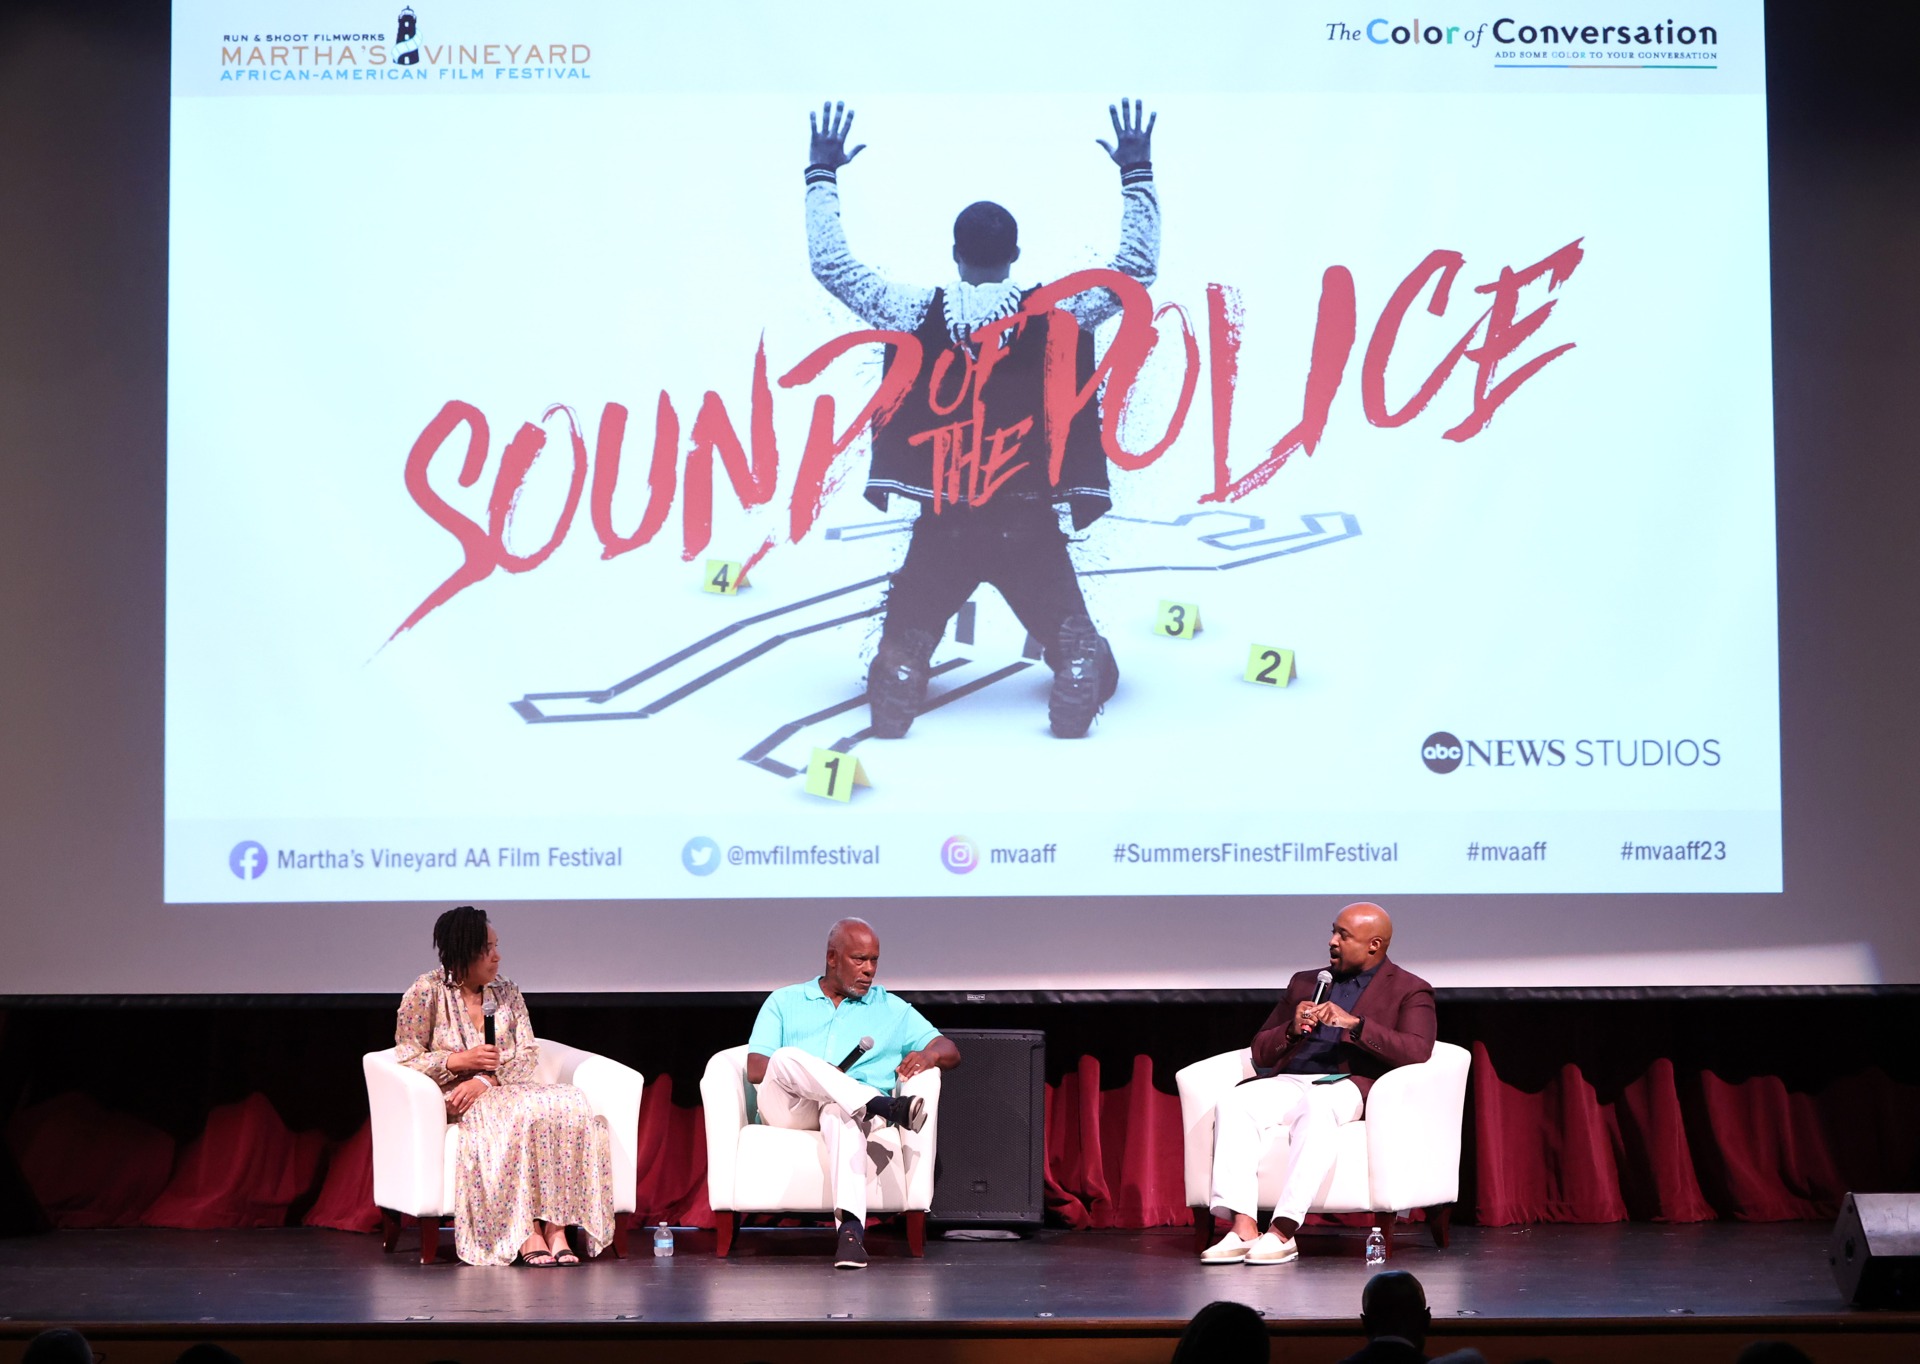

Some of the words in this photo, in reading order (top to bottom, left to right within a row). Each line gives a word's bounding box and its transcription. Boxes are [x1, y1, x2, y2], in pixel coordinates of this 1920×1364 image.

[223, 34, 249, 42] RUN
[253, 34, 262, 42] &
[265, 34, 310, 42] SHOOT
[313, 33, 385, 41] FILMWORKS
[1326, 22, 1361, 41] The
[1366, 18, 1460, 45] Color
[1464, 23, 1488, 48] of
[1492, 17, 1718, 45] Conversation
[221, 44, 387, 66] MARTHA'S
[423, 44, 591, 65] VINEYARD
[1495, 51, 1516, 59] ADD
[1519, 51, 1548, 59] SOME
[1551, 51, 1587, 59] COLOR
[1589, 51, 1603, 59] TO
[1607, 51, 1635, 59] YOUR
[1638, 51, 1718, 60] CONVERSATION
[220, 68, 428, 82] AFRICAN-AMERICAN
[439, 68, 484, 80] FILM
[495, 67, 591, 80] FESTIVAL
[929, 312, 1029, 416] OF
[1022, 237, 1585, 504] POLICE
[908, 402, 1034, 515] THE
[365, 327, 923, 662] SOUND
[712, 564, 729, 592] 4
[1165, 605, 1185, 636] 3
[1256, 650, 1281, 684] 2
[1423, 743, 1462, 760] abc
[1465, 739, 1566, 767] NEWS
[1575, 739, 1721, 767] STUDIOS
[825, 757, 840, 797] 1
[277, 848, 365, 869] Martha's
[371, 847, 457, 872] Vineyard
[464, 847, 491, 867] AA
[498, 847, 540, 867] Film
[548, 846, 622, 867] Festival
[727, 845, 880, 866] @mvfilmfestival
[990, 844, 1057, 864] mvaaff
[1113, 842, 1398, 863] #SummersFinestFilmFestival
[1467, 841, 1548, 861] #mvaaff
[1620, 841, 1727, 861] #mvaaff23
